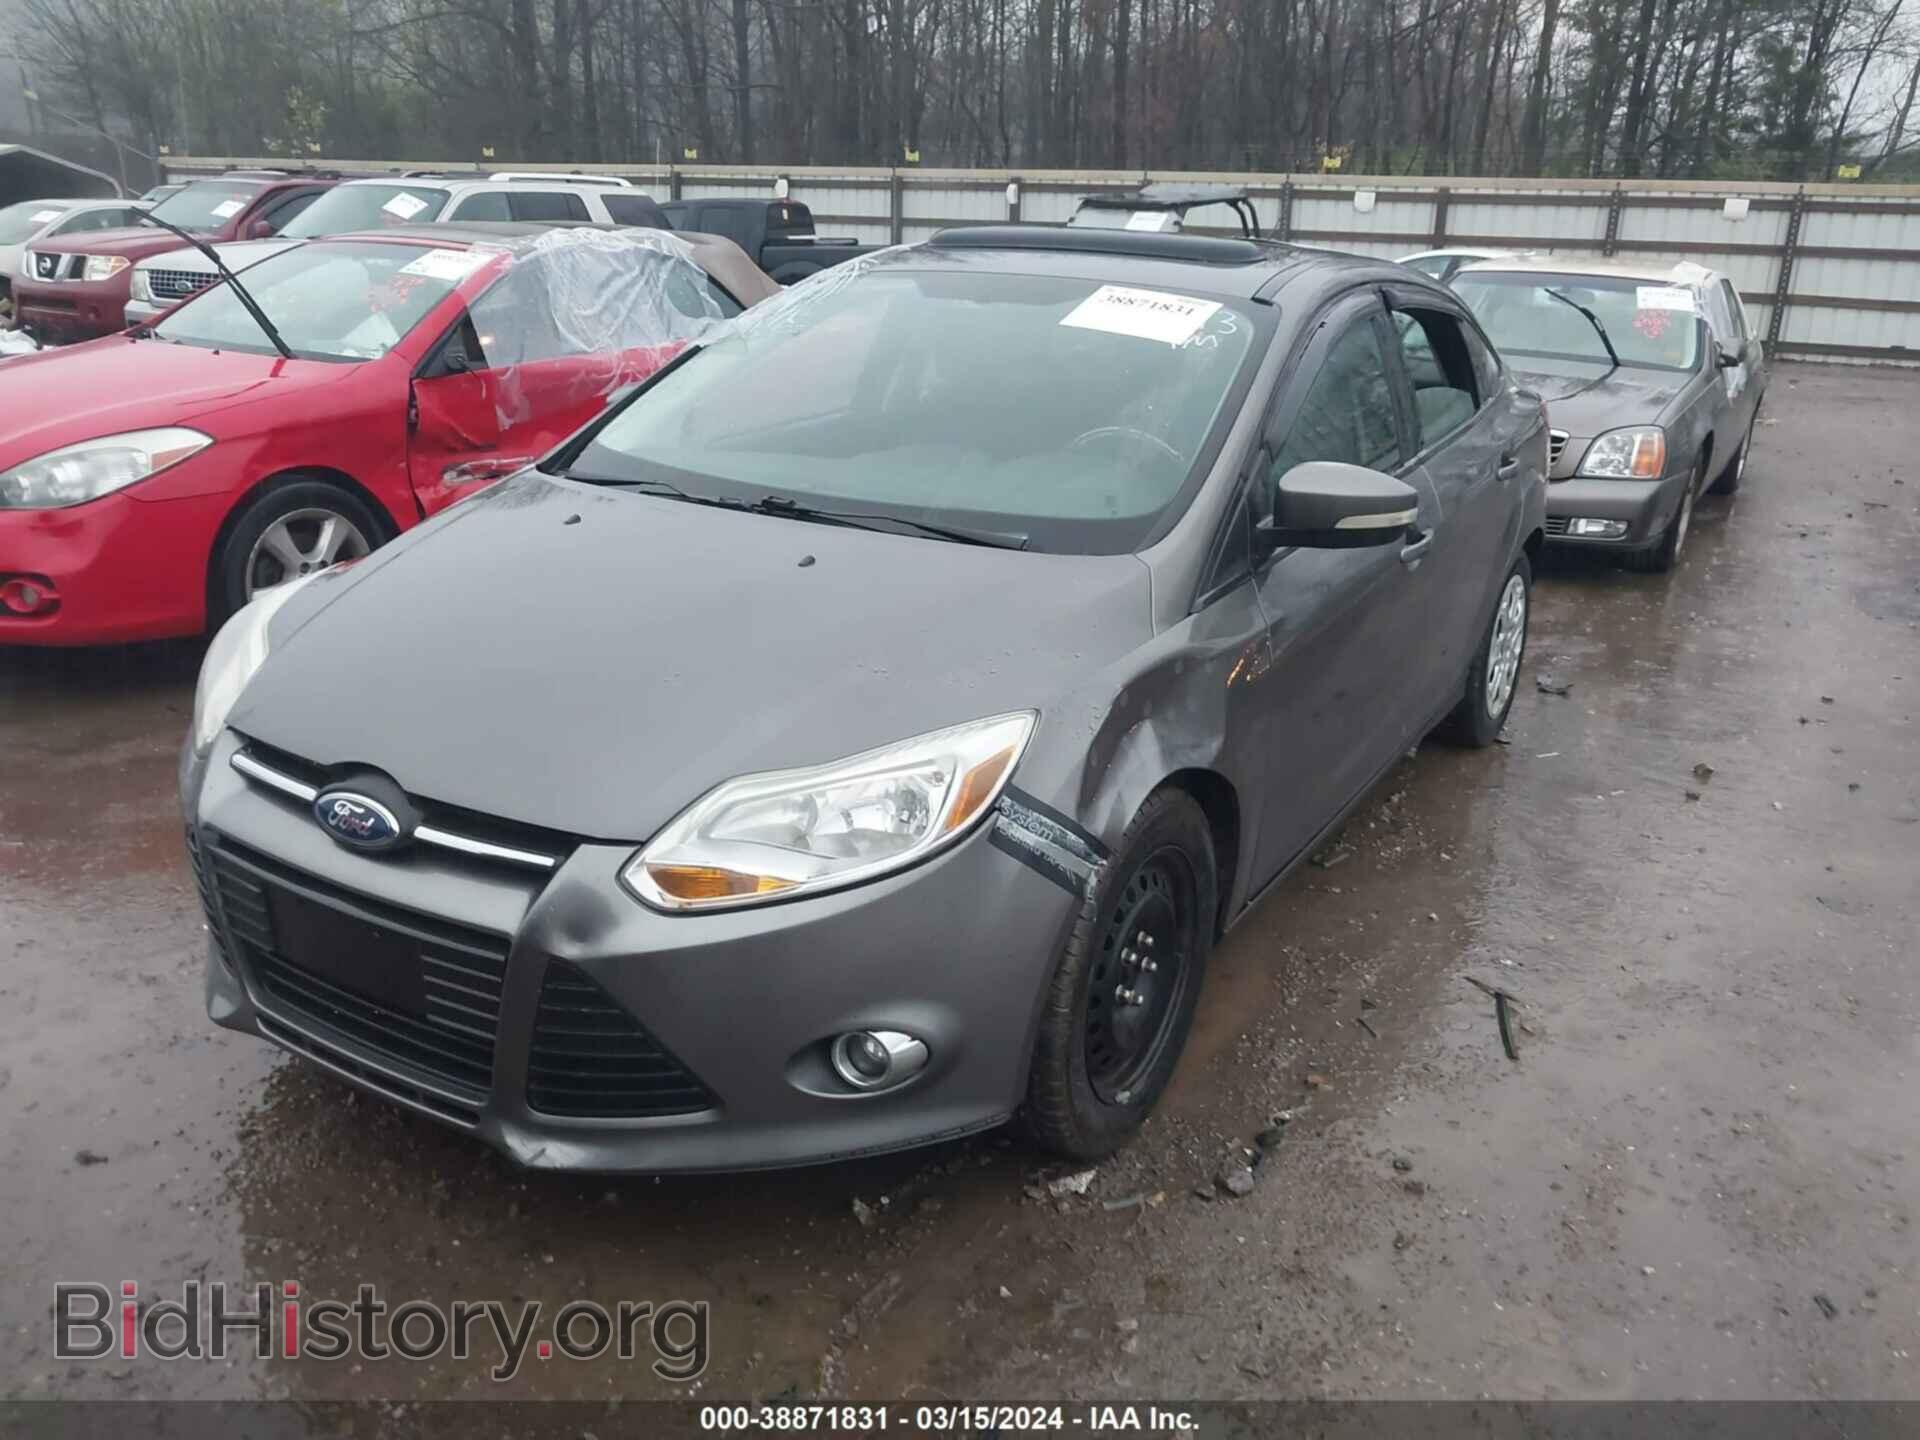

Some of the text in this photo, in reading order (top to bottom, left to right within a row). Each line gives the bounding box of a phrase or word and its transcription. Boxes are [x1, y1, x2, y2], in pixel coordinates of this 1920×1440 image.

[1105, 294, 1195, 316] 38871831
[327, 799, 376, 836] Ford
[1001, 805, 1054, 841] system
